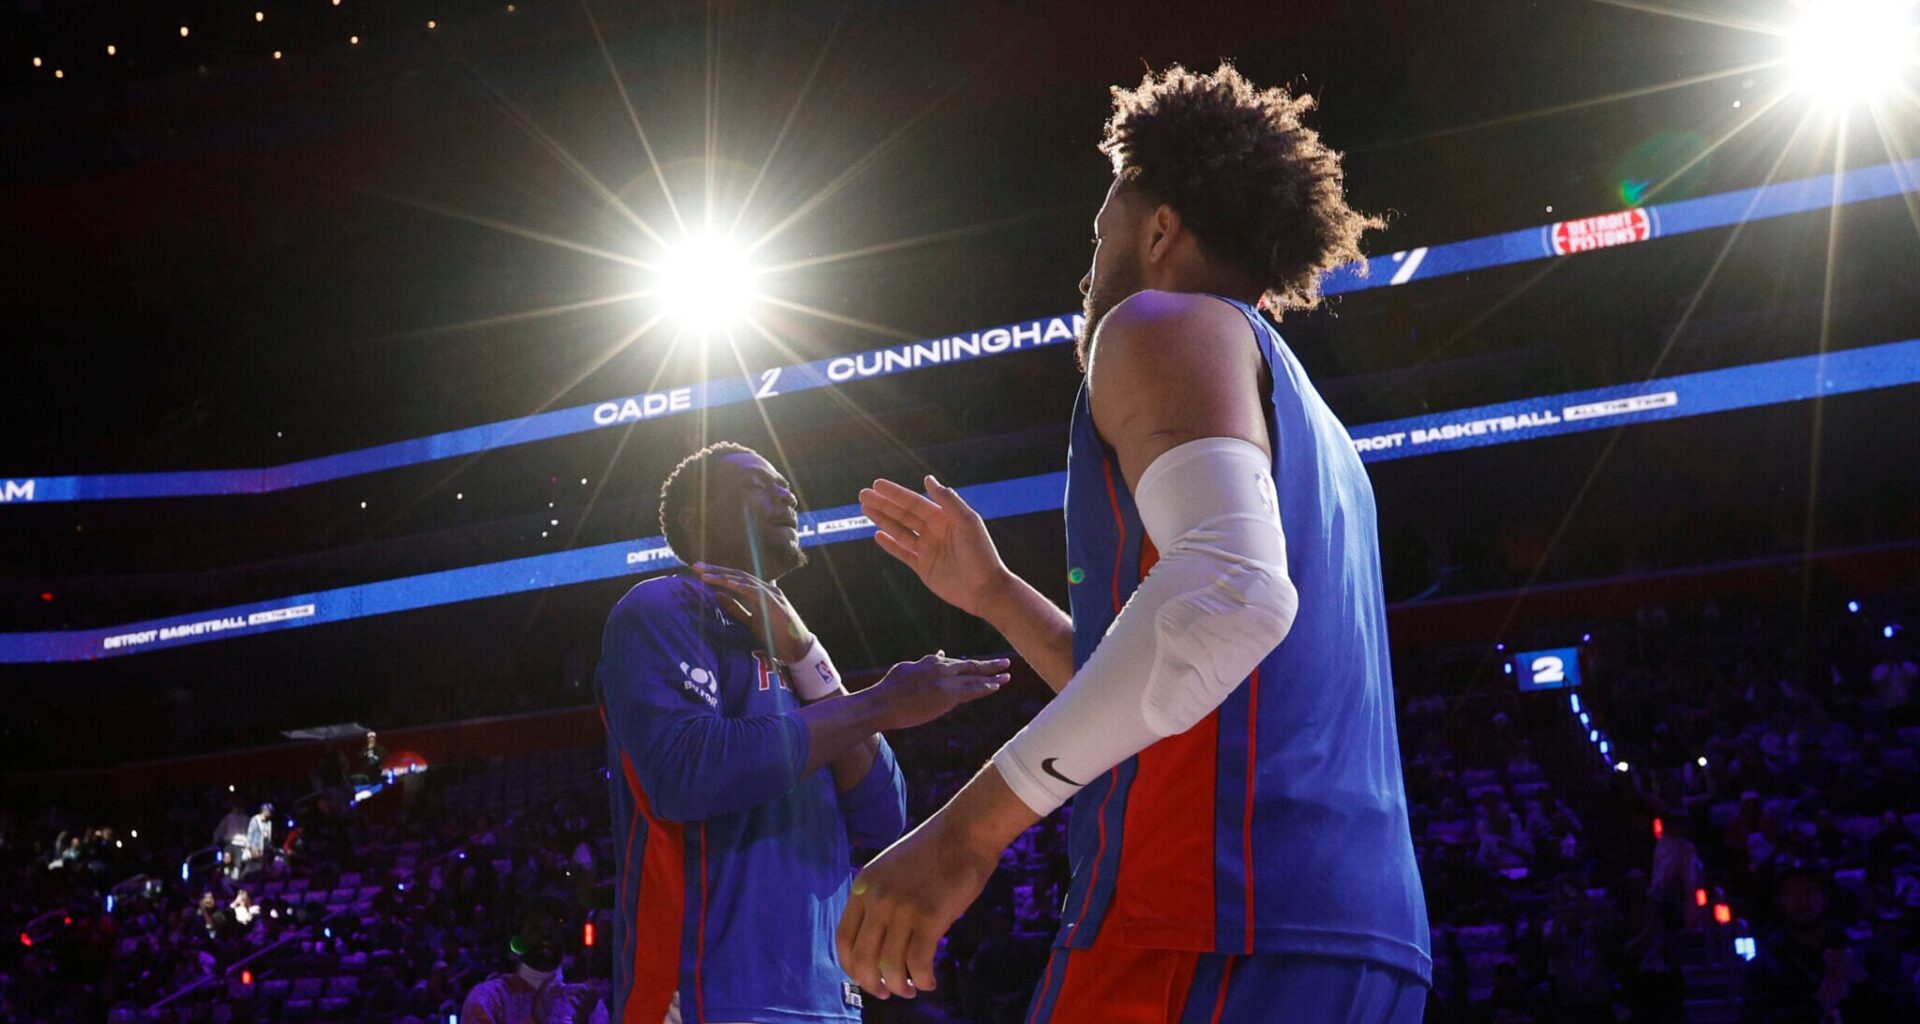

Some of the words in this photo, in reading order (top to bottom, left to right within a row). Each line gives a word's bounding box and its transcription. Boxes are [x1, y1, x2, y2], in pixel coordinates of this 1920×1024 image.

[1567, 210, 1632, 237] DETROIT
[1569, 227, 1637, 253] PISTONS
[593, 387, 691, 425] CADE
[755, 367, 782, 400] 2
[1411, 410, 1561, 444] BASKETBALL
[103, 630, 158, 649] DETROIT
[160, 616, 246, 640] BASKETBALL
[1531, 656, 1564, 683] 2
